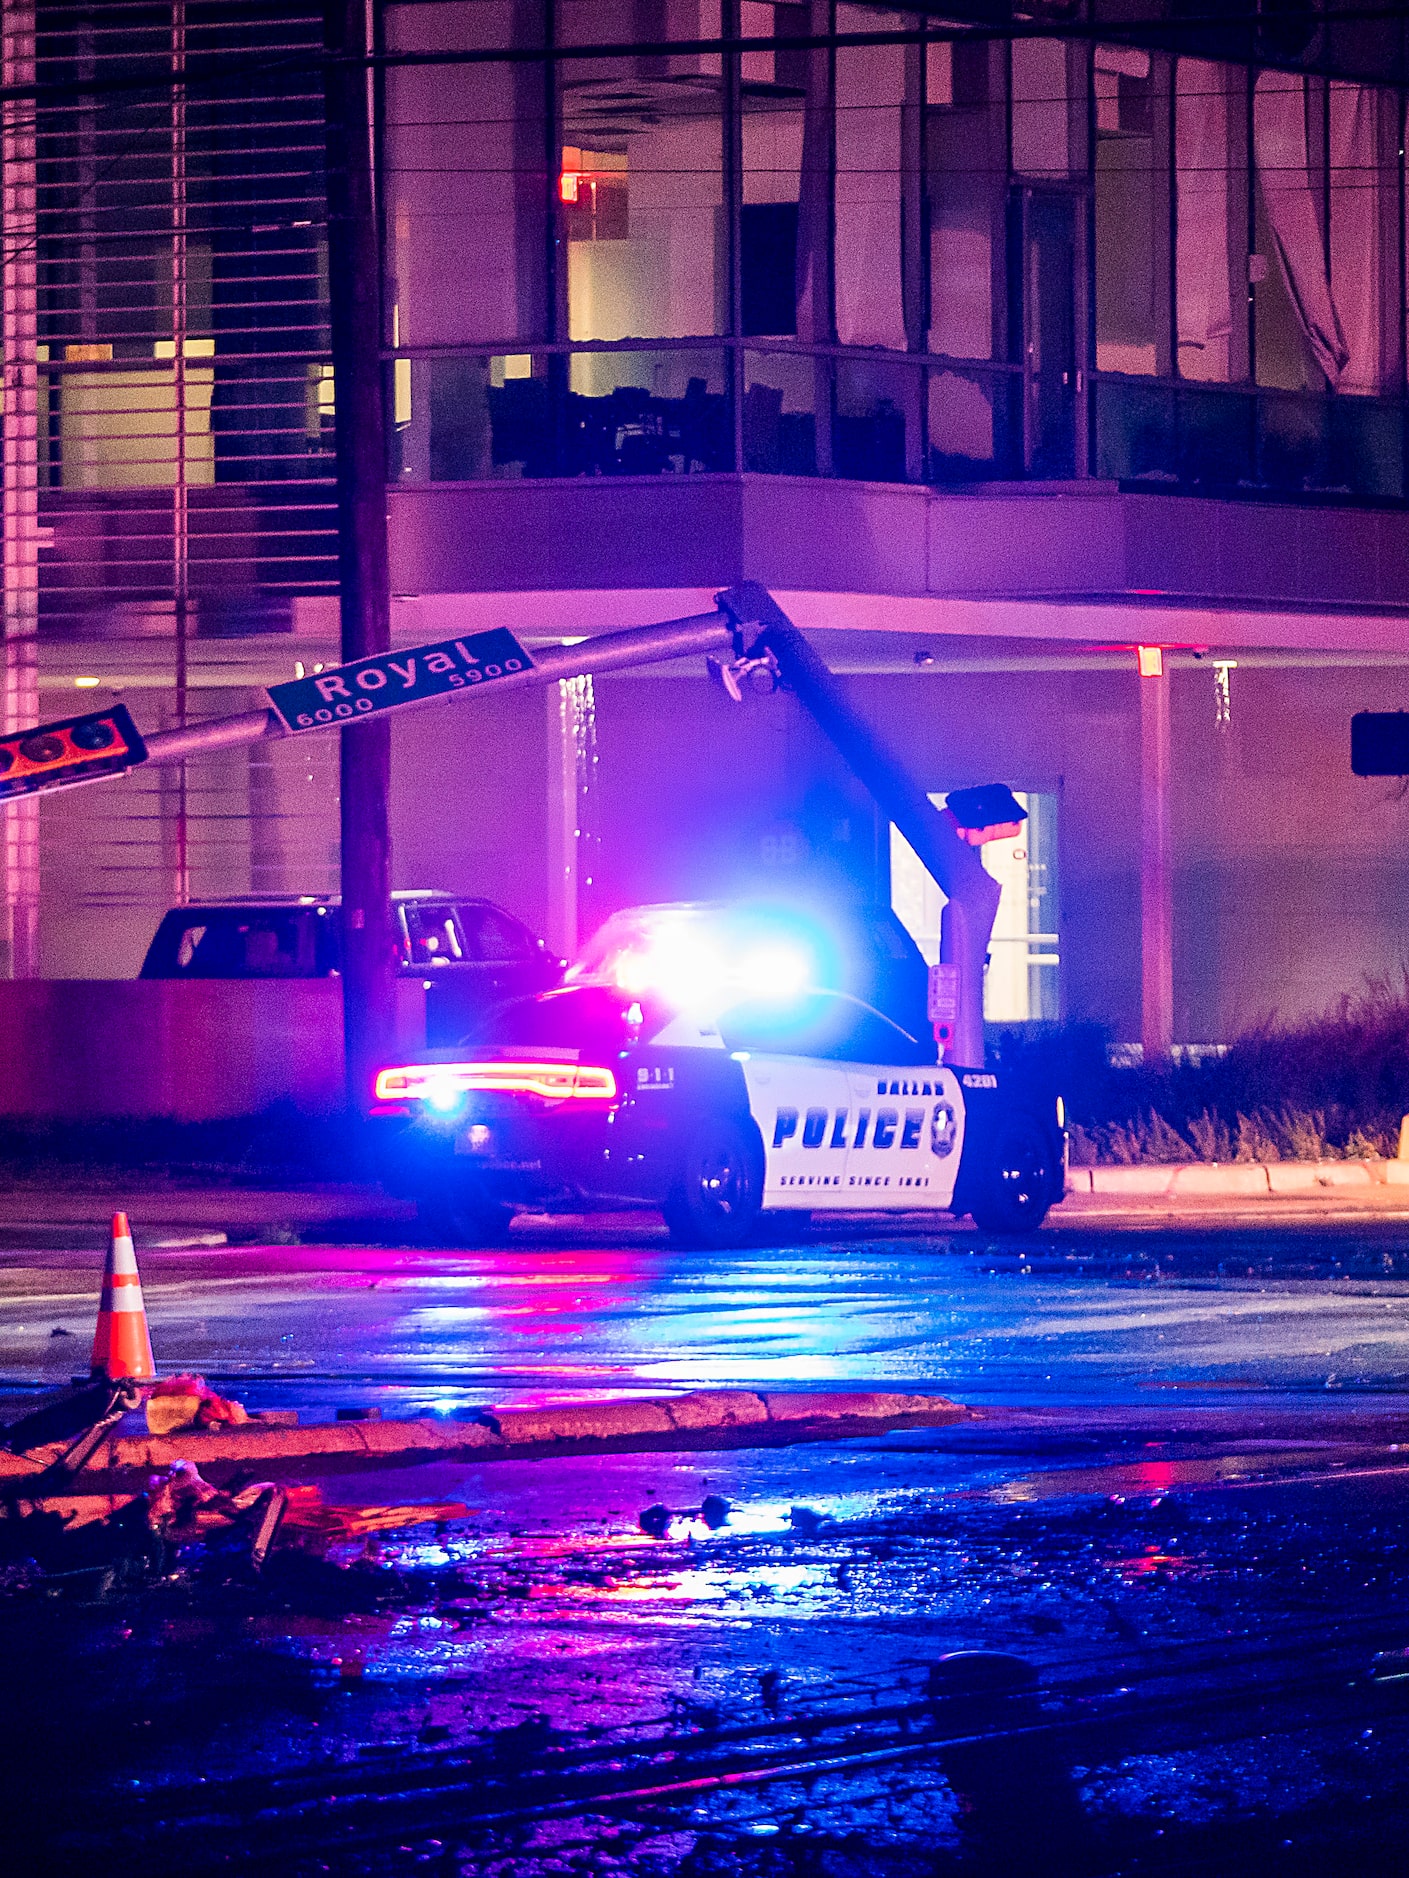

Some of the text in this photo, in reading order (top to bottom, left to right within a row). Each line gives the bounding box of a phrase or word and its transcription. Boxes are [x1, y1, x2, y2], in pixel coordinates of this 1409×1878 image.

[314, 641, 480, 702] Royal
[448, 658, 523, 687] 5900
[296, 697, 375, 726] 6000
[877, 1078, 945, 1096] DALLAS
[773, 1106, 926, 1149] POLICE
[780, 1176, 930, 1187] SERVING SINCE 1881
